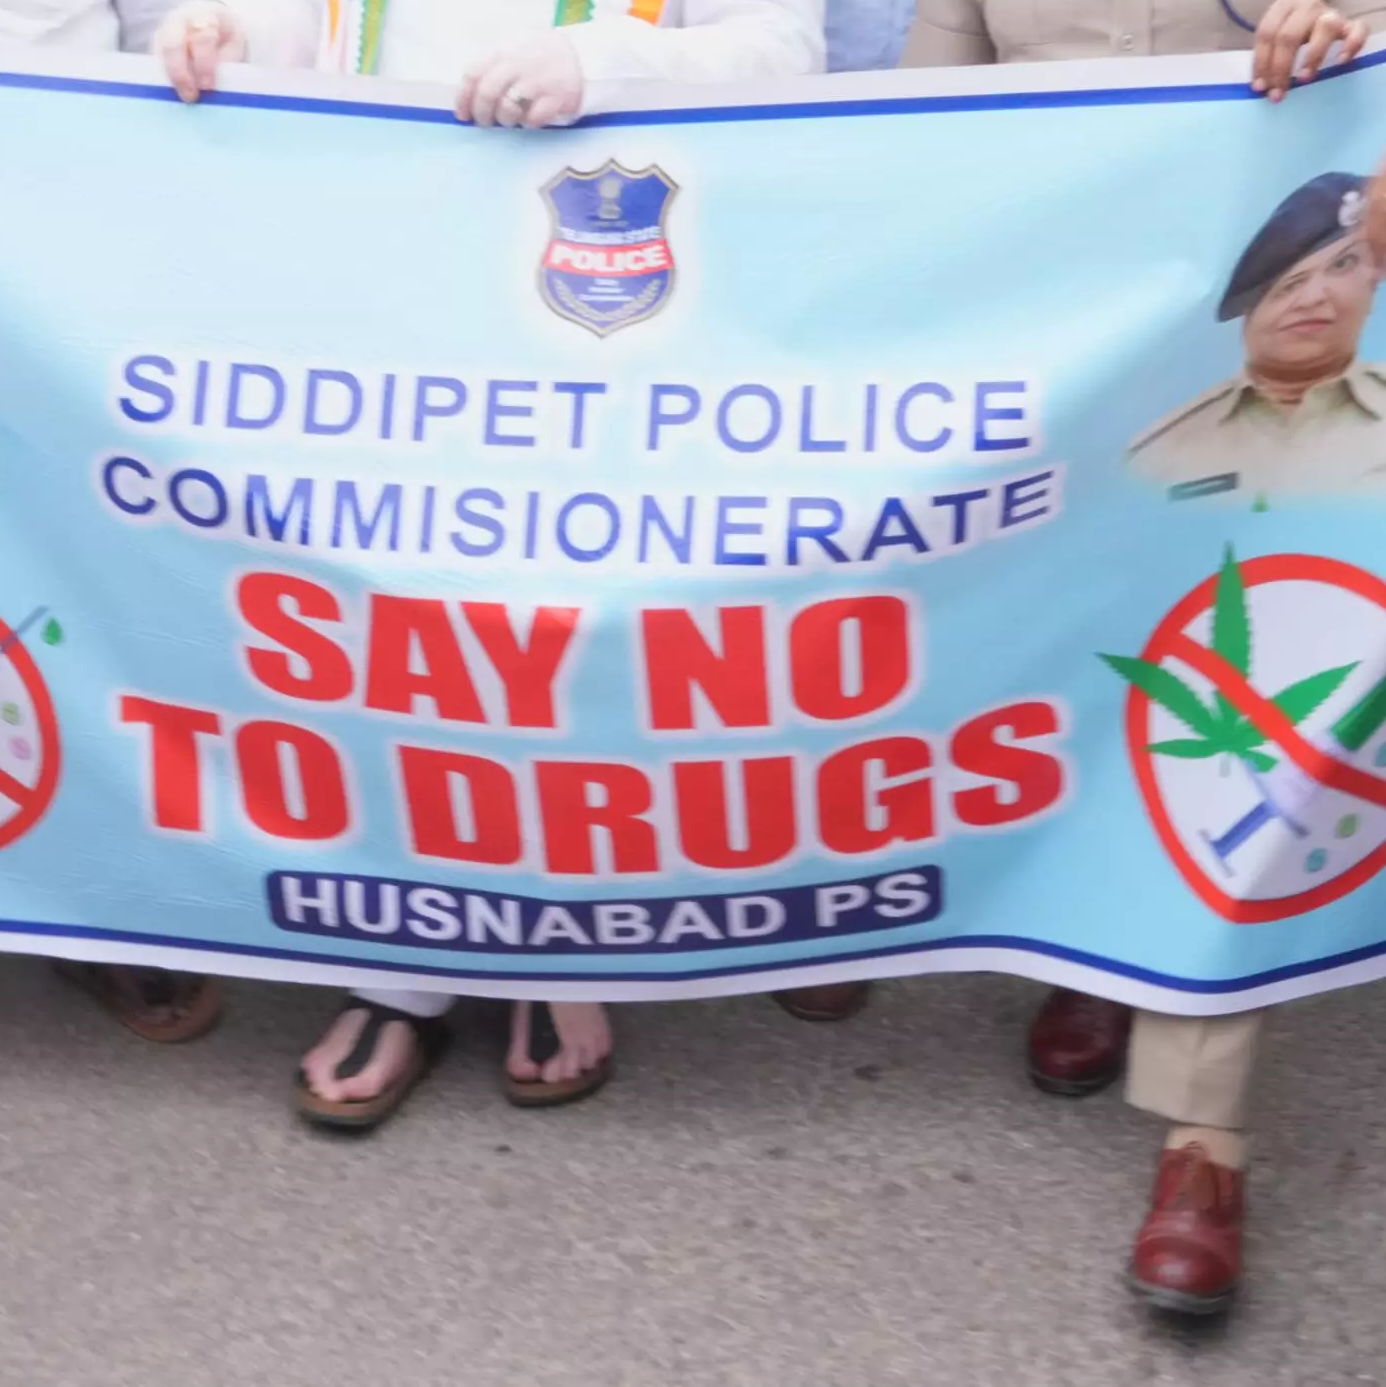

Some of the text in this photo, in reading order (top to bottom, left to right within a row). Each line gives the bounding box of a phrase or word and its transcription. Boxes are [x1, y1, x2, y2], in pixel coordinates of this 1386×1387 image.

[551, 246, 668, 272] POLICE
[117, 354, 1032, 454] SIDDIPET POLICE
[100, 453, 1054, 569] COMMISIONERATE
[237, 572, 910, 731] SAY NO
[121, 695, 1062, 875] TO DRUGS
[283, 873, 929, 945] HUSNABAD PS
